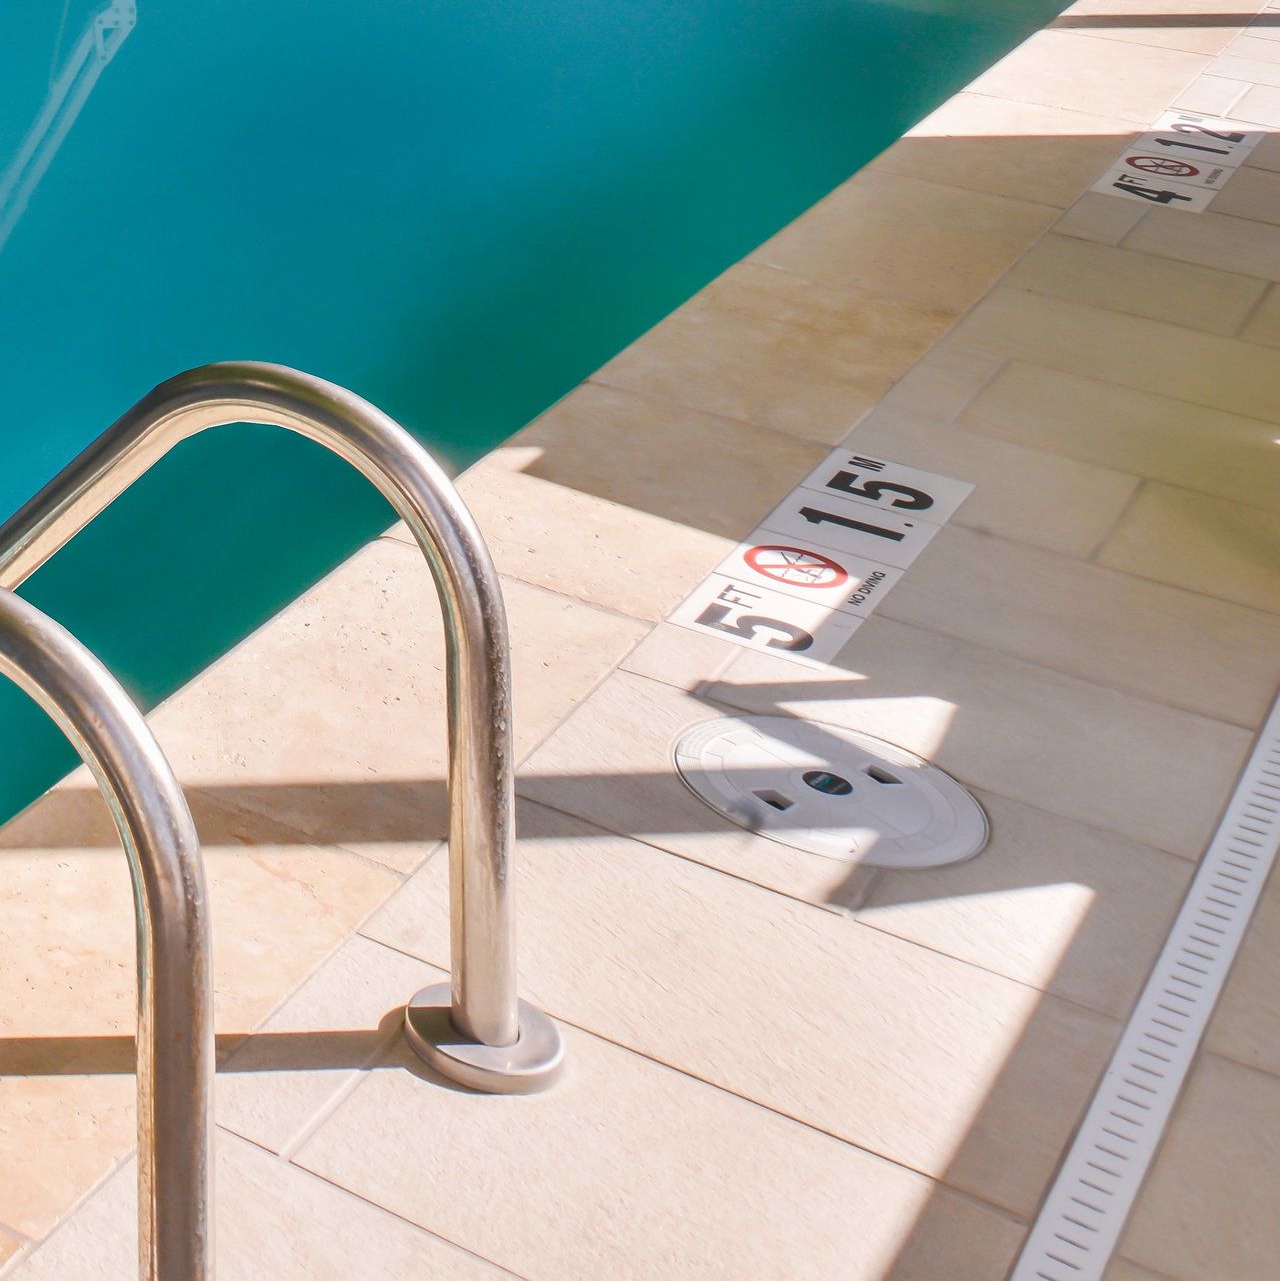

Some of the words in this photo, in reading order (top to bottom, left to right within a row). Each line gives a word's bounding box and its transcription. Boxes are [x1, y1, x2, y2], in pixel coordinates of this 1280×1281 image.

[1112, 182, 1192, 204] 4
[848, 455, 886, 472] M
[716, 584, 761, 609] FT
[847, 593, 866, 607] NO
[857, 571, 886, 595] DIVING
[694, 601, 814, 652] 5
